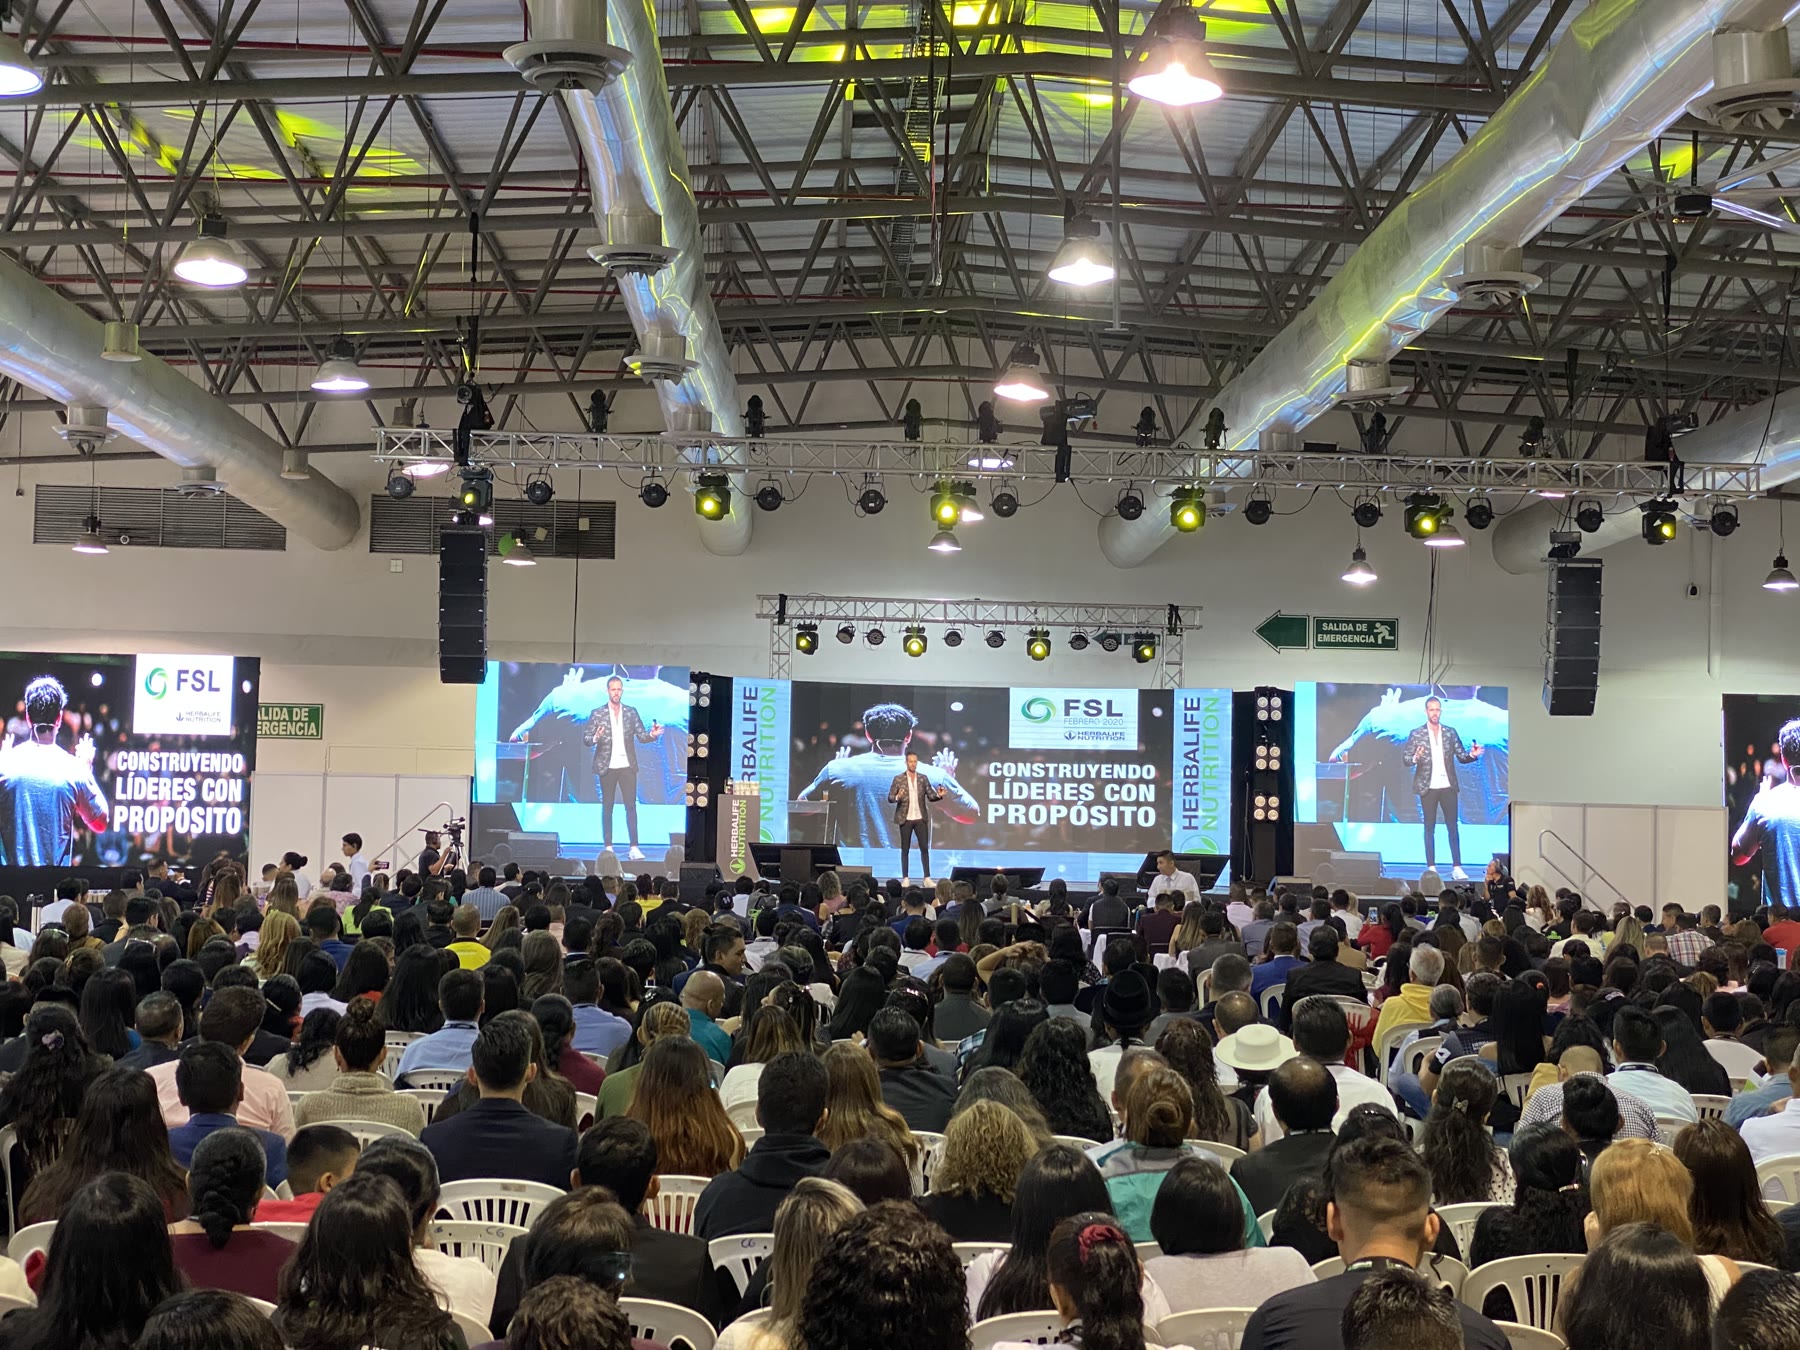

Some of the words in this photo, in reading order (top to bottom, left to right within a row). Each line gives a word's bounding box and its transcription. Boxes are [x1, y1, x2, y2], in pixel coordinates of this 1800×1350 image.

[1317, 633, 1375, 643] EMERGENCIA
[1322, 622, 1354, 632] SALIDA
[1356, 623, 1368, 632] DE
[176, 669, 221, 692] FSL
[292, 707, 309, 721] DE
[1064, 699, 1123, 717] FSL
[1064, 717, 1099, 726] FEBRERO
[1103, 718, 1124, 726] 2020
[117, 751, 243, 773] CONSTRUYENDO
[759, 687, 777, 822] NUTRITION
[1182, 697, 1201, 831] HERBALIFE
[1201, 697, 1220, 831] NUTRITION
[989, 762, 1156, 780] CONSTRUYENDO
[115, 772, 197, 801] LÍDERES
[201, 777, 243, 802] CON
[988, 778, 1095, 801] LÍDERES
[1104, 783, 1156, 802] CON
[113, 801, 242, 835] PROPÓSITO
[987, 801, 1156, 828] PROPÓSITO
[730, 799, 740, 858] HERBALIFE
[738, 799, 747, 858] NUTRITION
